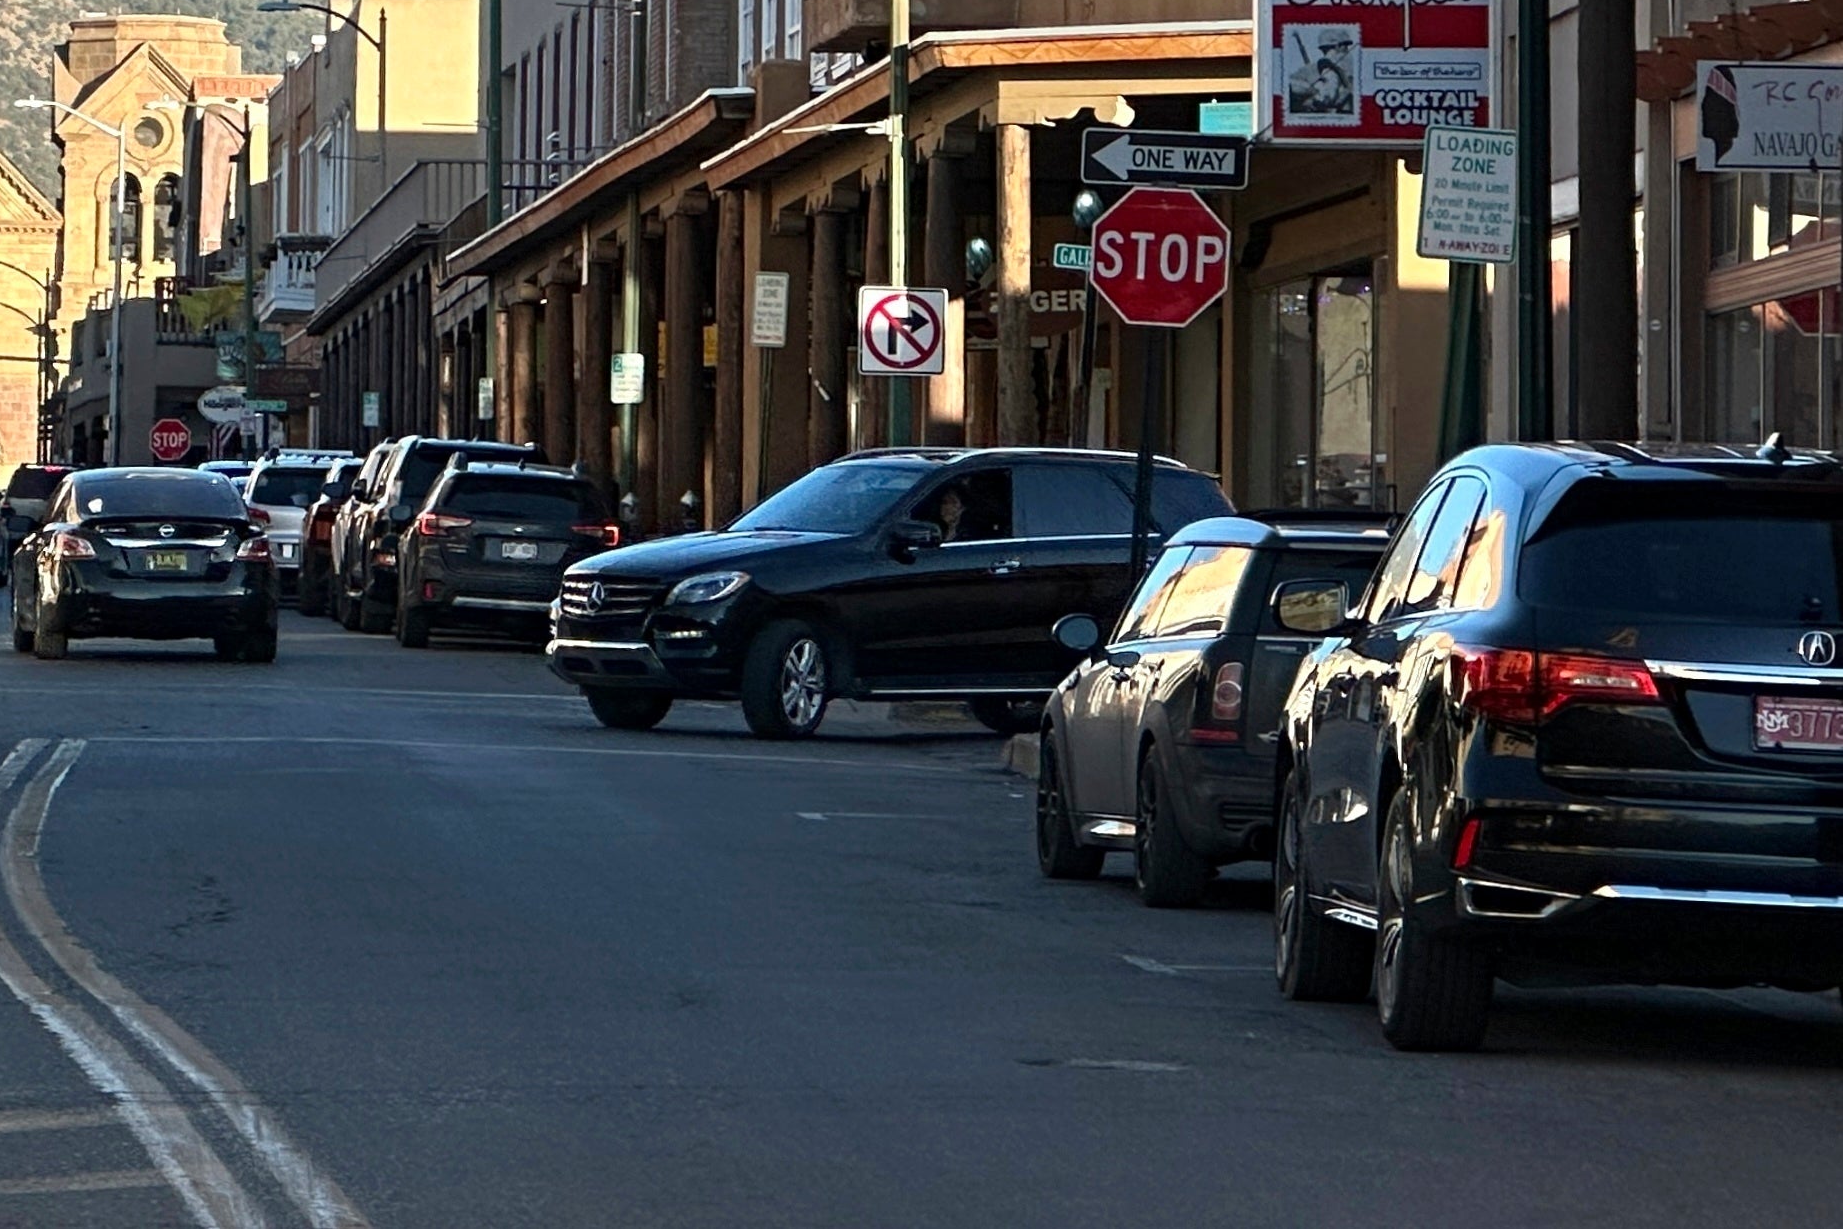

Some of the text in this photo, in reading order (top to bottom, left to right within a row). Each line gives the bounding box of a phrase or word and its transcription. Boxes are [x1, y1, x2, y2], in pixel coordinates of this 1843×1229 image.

[1374, 90, 1479, 109] COCKTAIL
[1382, 109, 1475, 125] LOUNGE
[1436, 135, 1514, 156] LOADING
[1753, 132, 1819, 157] NAVAJO
[1132, 148, 1229, 170] ONE WAY
[1451, 156, 1497, 175] ZONE
[1096, 230, 1225, 283] STOP
[153, 433, 188, 448] STOP
